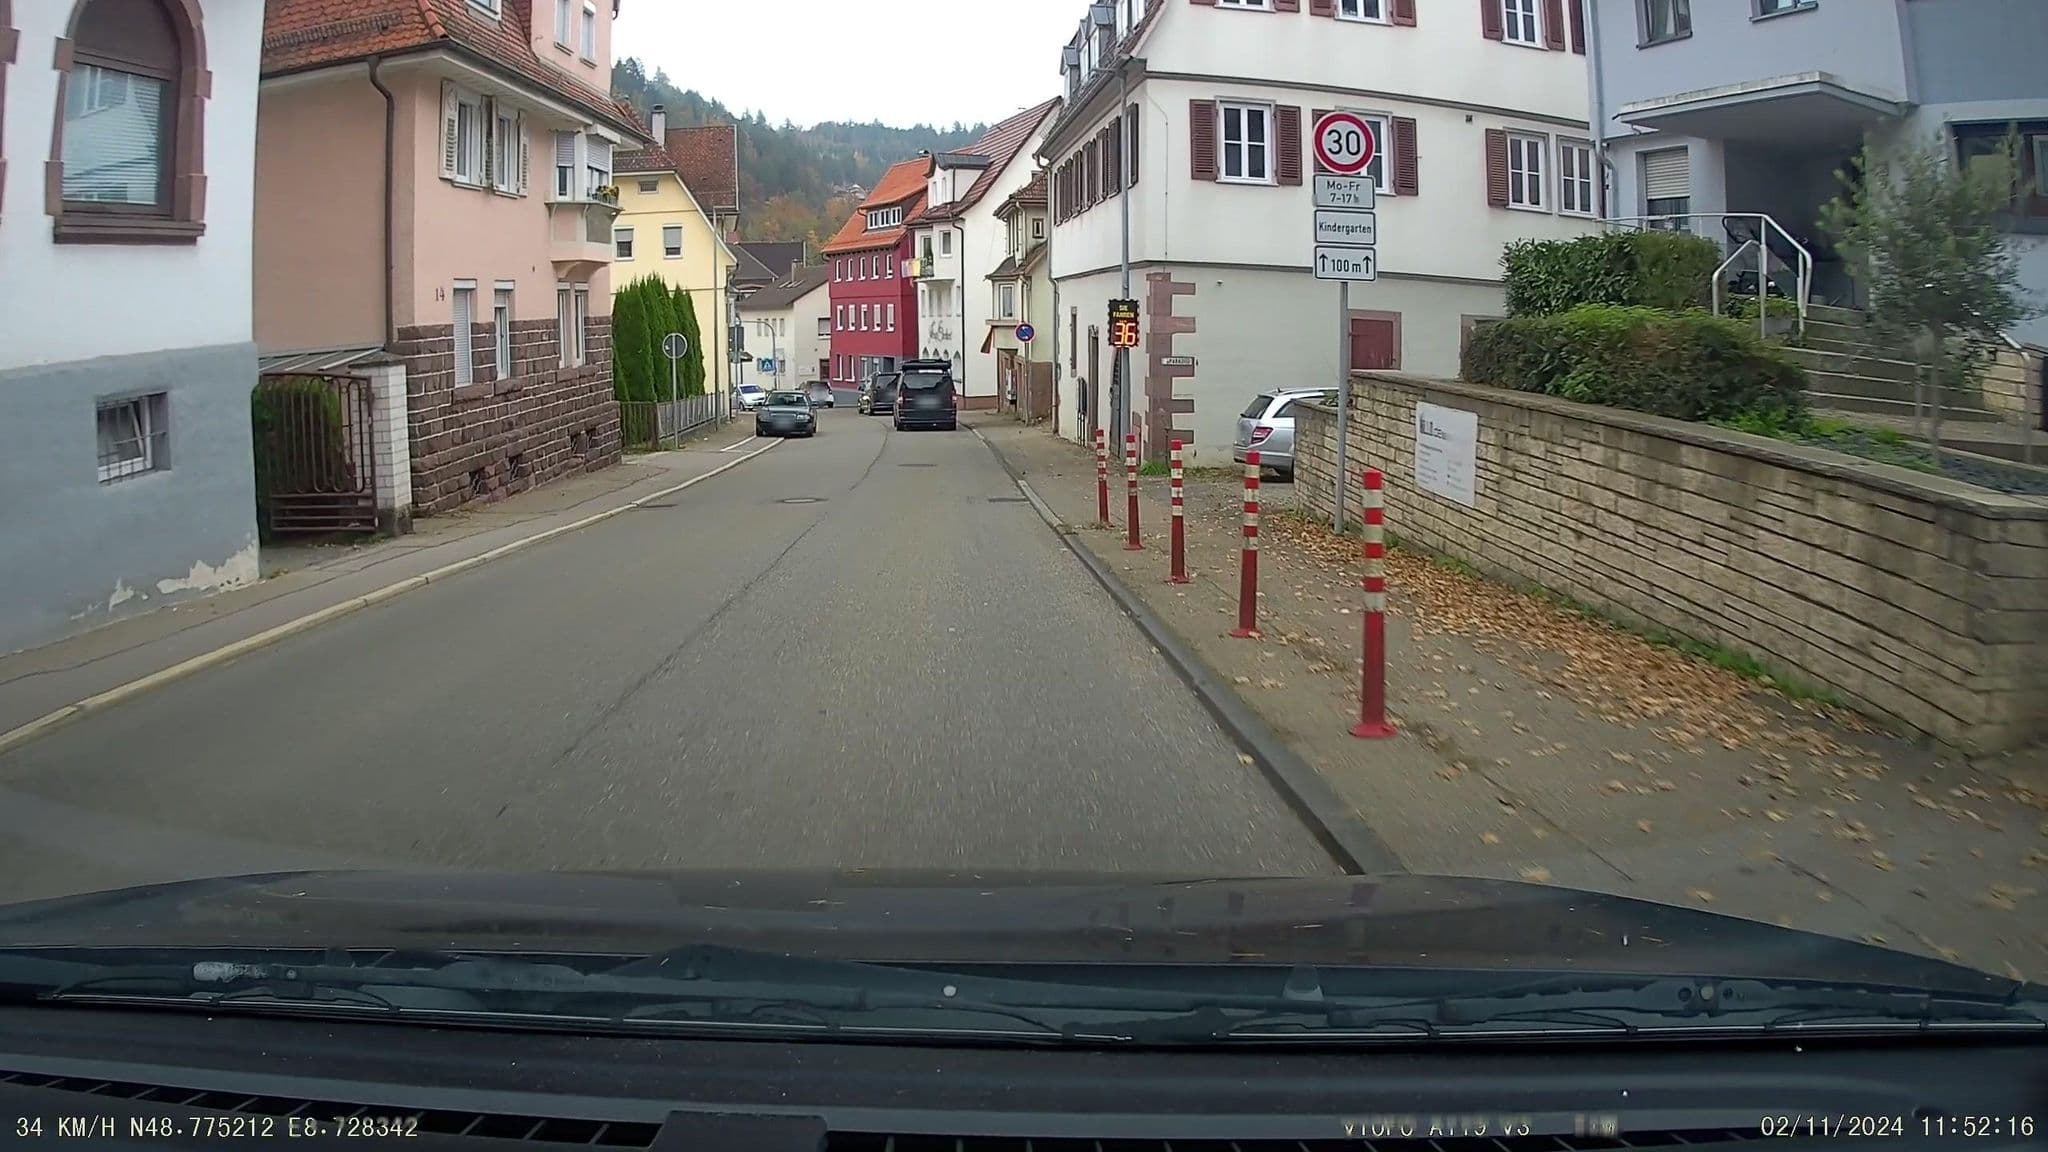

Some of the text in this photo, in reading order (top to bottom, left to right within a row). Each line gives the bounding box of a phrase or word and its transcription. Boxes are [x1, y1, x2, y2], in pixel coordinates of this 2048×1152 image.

[1327, 129, 1361, 156] 30
[1326, 180, 1361, 191] Mo-Fr
[1318, 221, 1372, 236] Kindergarten
[1331, 259, 1361, 273] 100 m
[435, 287, 445, 301] 14
[1114, 322, 1136, 345] 36
